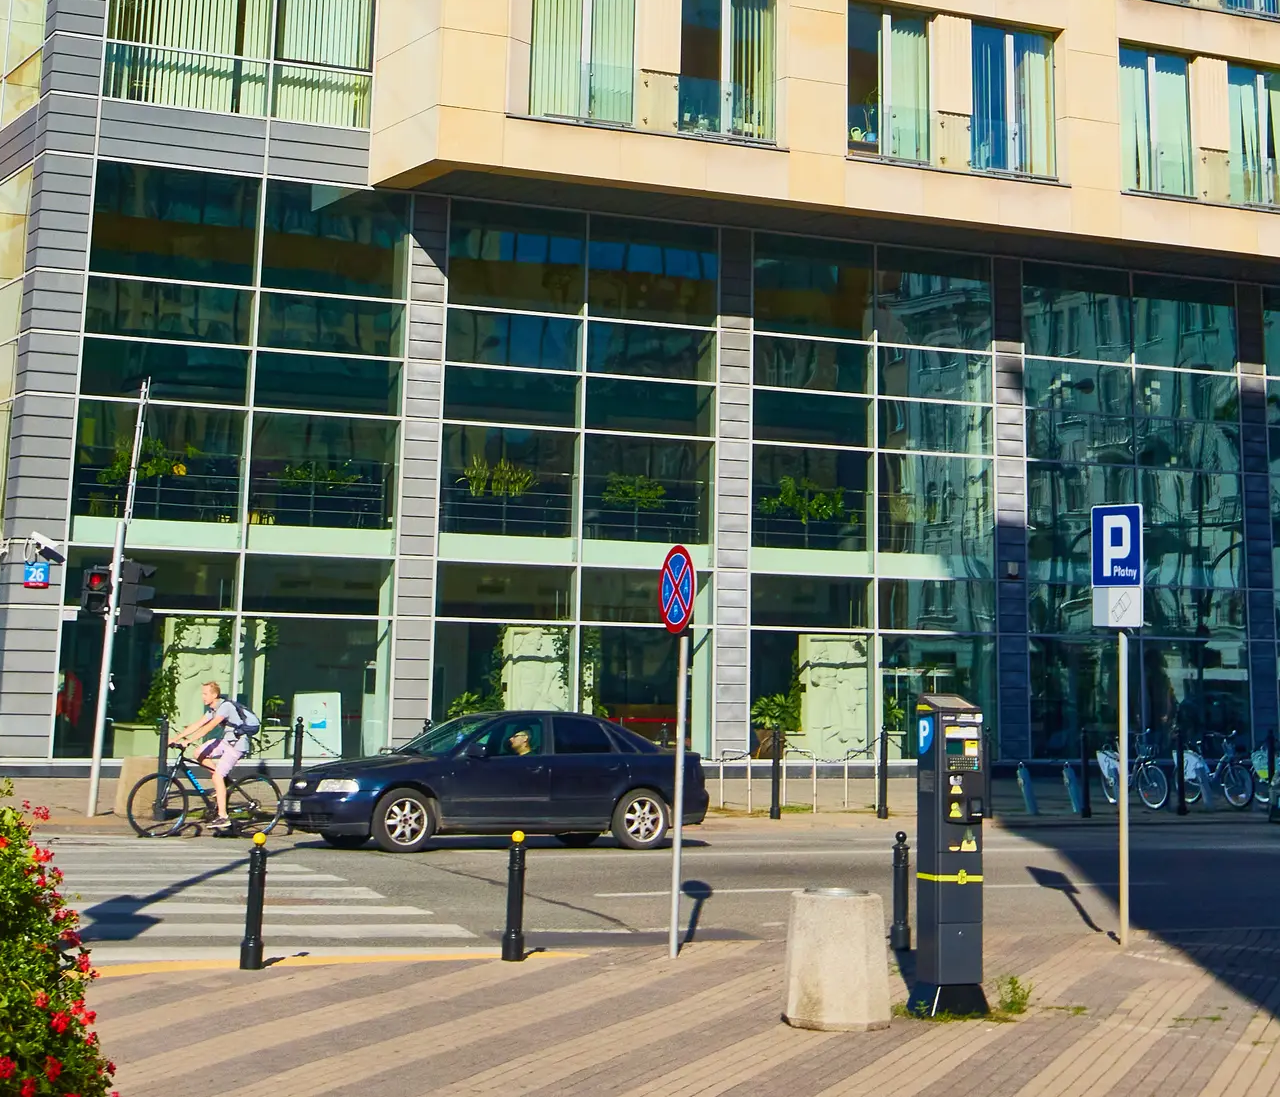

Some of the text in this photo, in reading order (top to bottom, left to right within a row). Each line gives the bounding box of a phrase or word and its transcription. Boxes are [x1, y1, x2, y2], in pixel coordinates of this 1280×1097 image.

[1103, 514, 1131, 577] P
[28, 567, 45, 582] 26
[1113, 564, 1138, 580] Płatny
[919, 719, 930, 748] P
